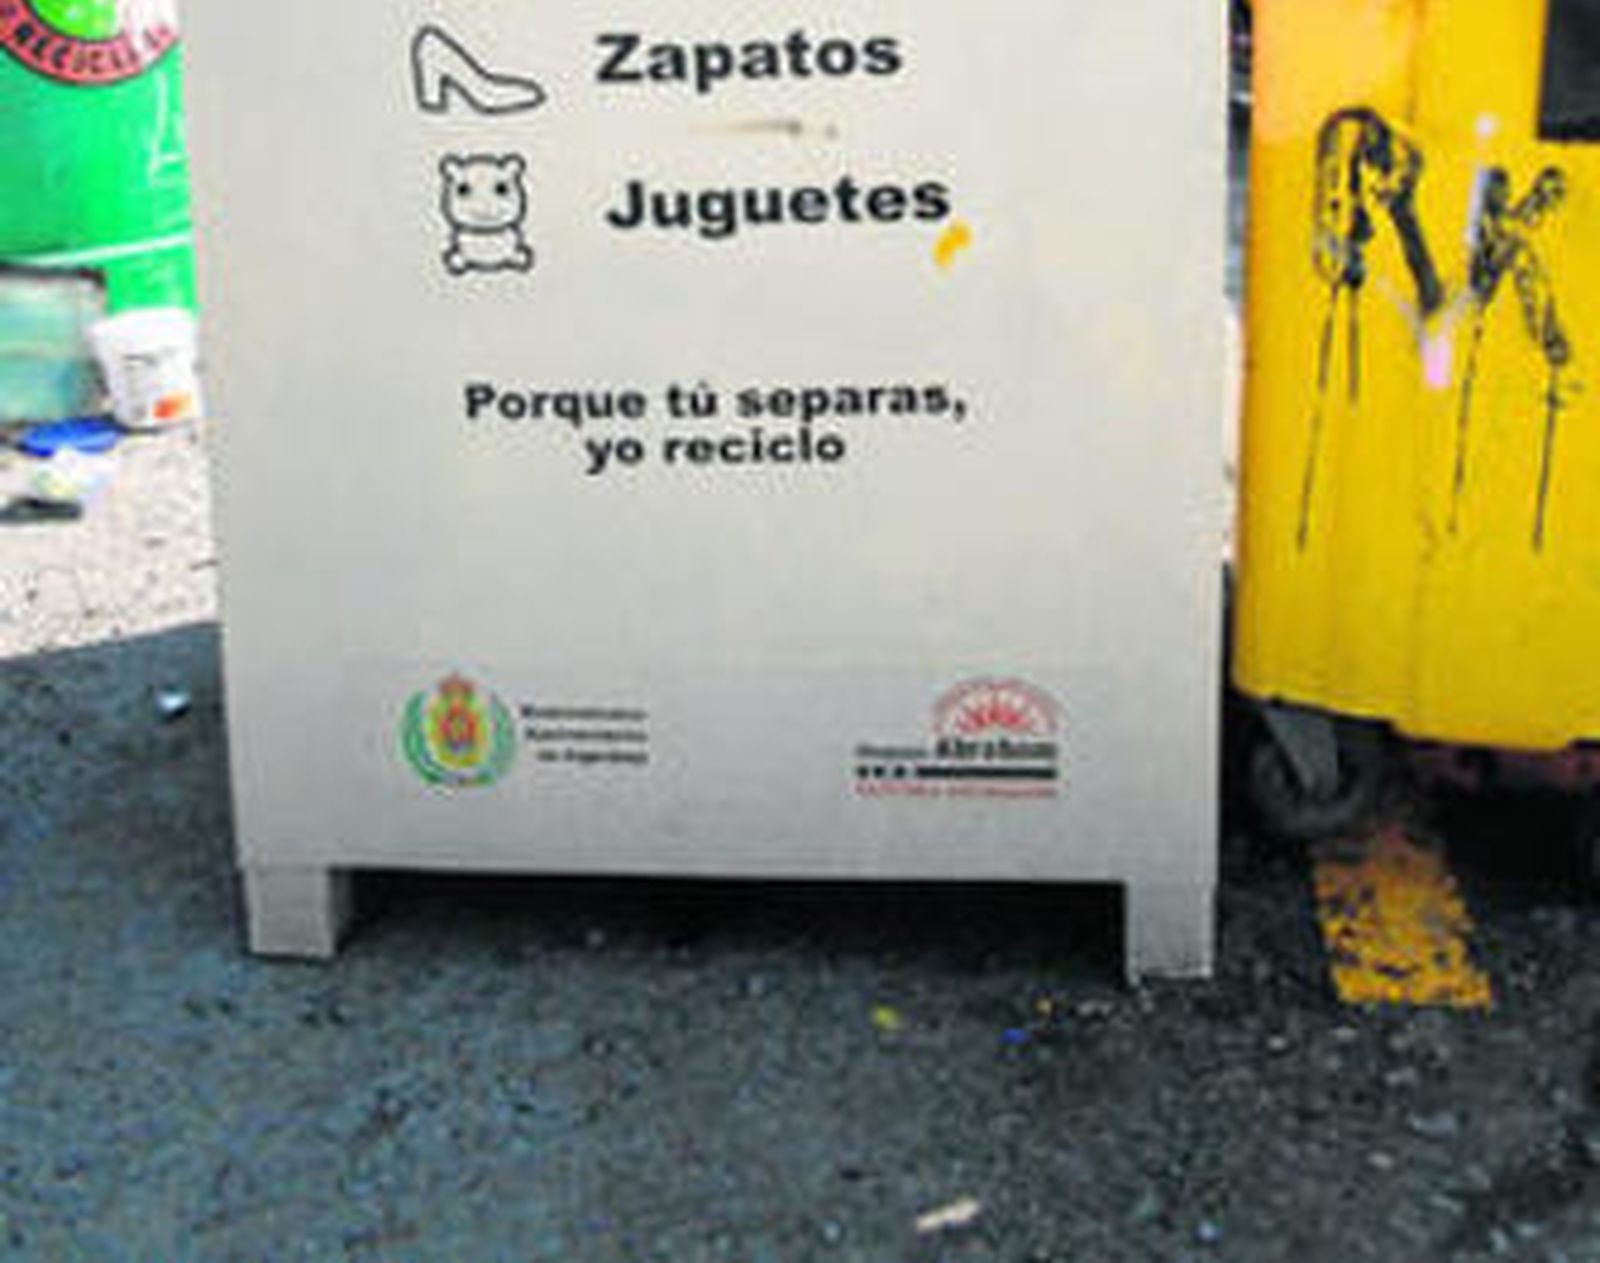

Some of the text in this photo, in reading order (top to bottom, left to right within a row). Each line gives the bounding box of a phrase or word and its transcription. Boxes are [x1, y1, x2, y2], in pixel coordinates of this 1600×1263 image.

[595, 30, 902, 94] Zapatos
[605, 175, 951, 240] Juguetes
[464, 382, 967, 428] Porque tú separas,
[584, 427, 847, 476] yo reciclo
